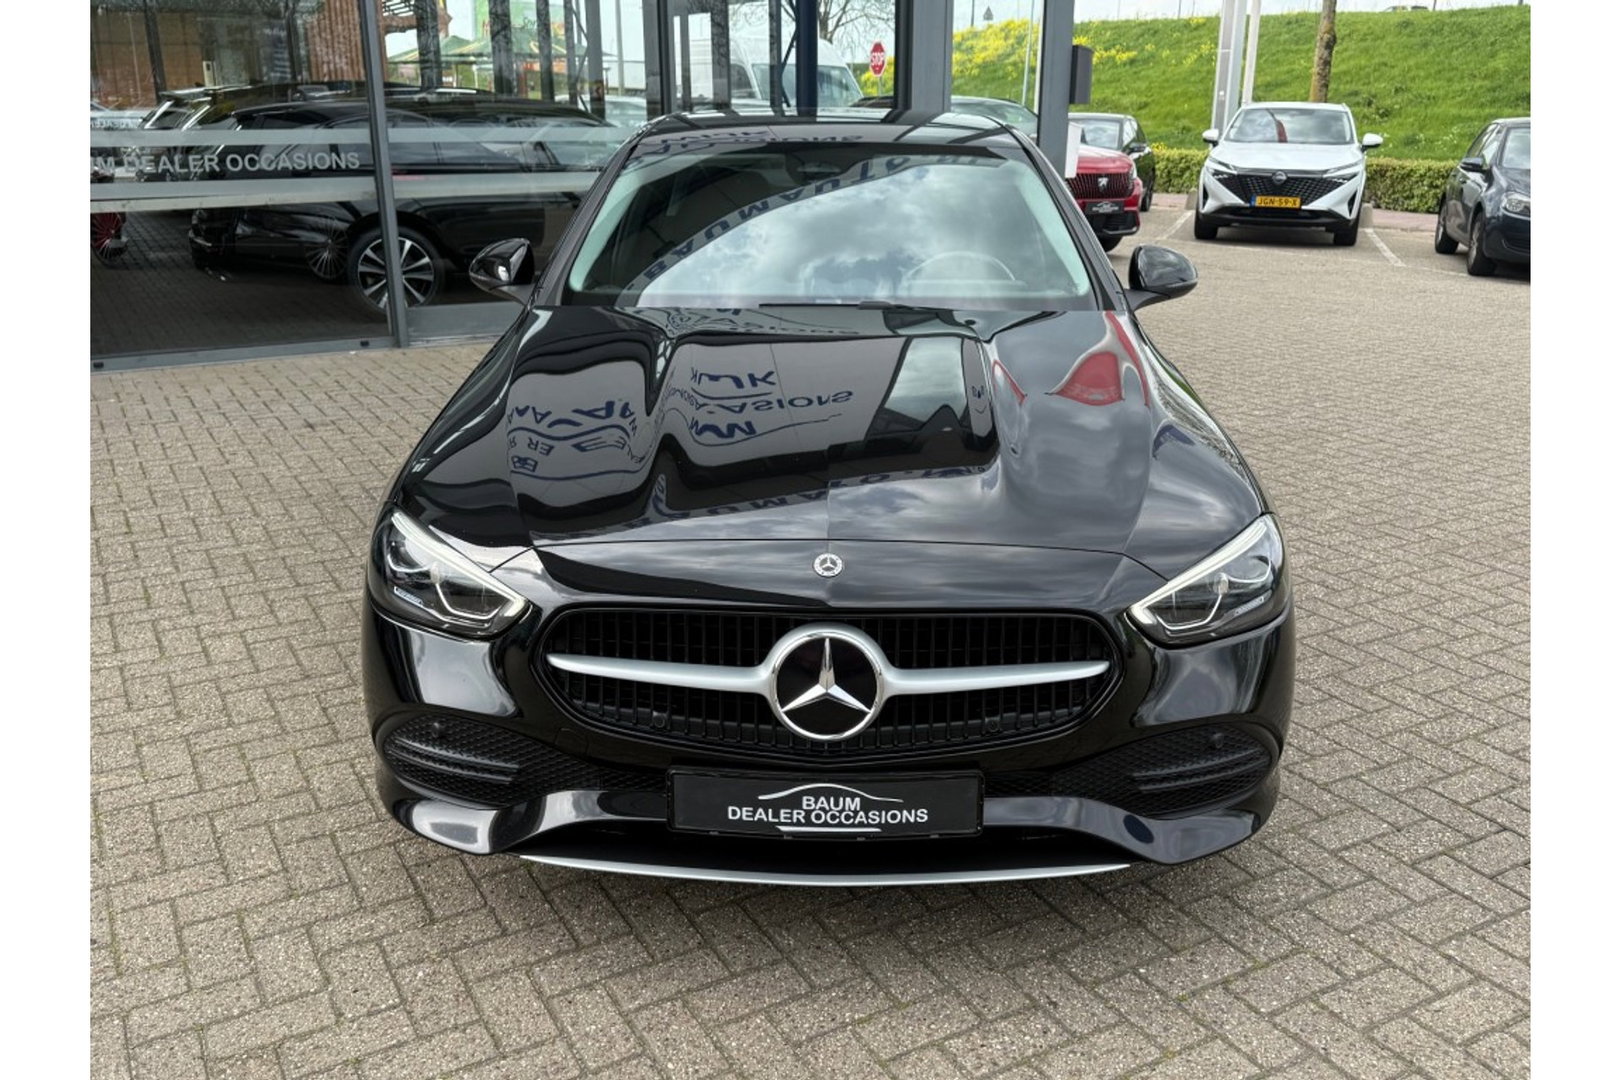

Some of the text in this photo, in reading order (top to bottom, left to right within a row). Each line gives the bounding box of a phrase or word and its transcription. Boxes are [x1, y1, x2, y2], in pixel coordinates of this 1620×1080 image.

[871, 52, 885, 65] STOP
[125, 155, 220, 173] DEALER
[226, 153, 360, 171] OCCASIONS
[802, 796, 861, 811] BAUM
[728, 806, 929, 825] DEALER OCCASIONS
